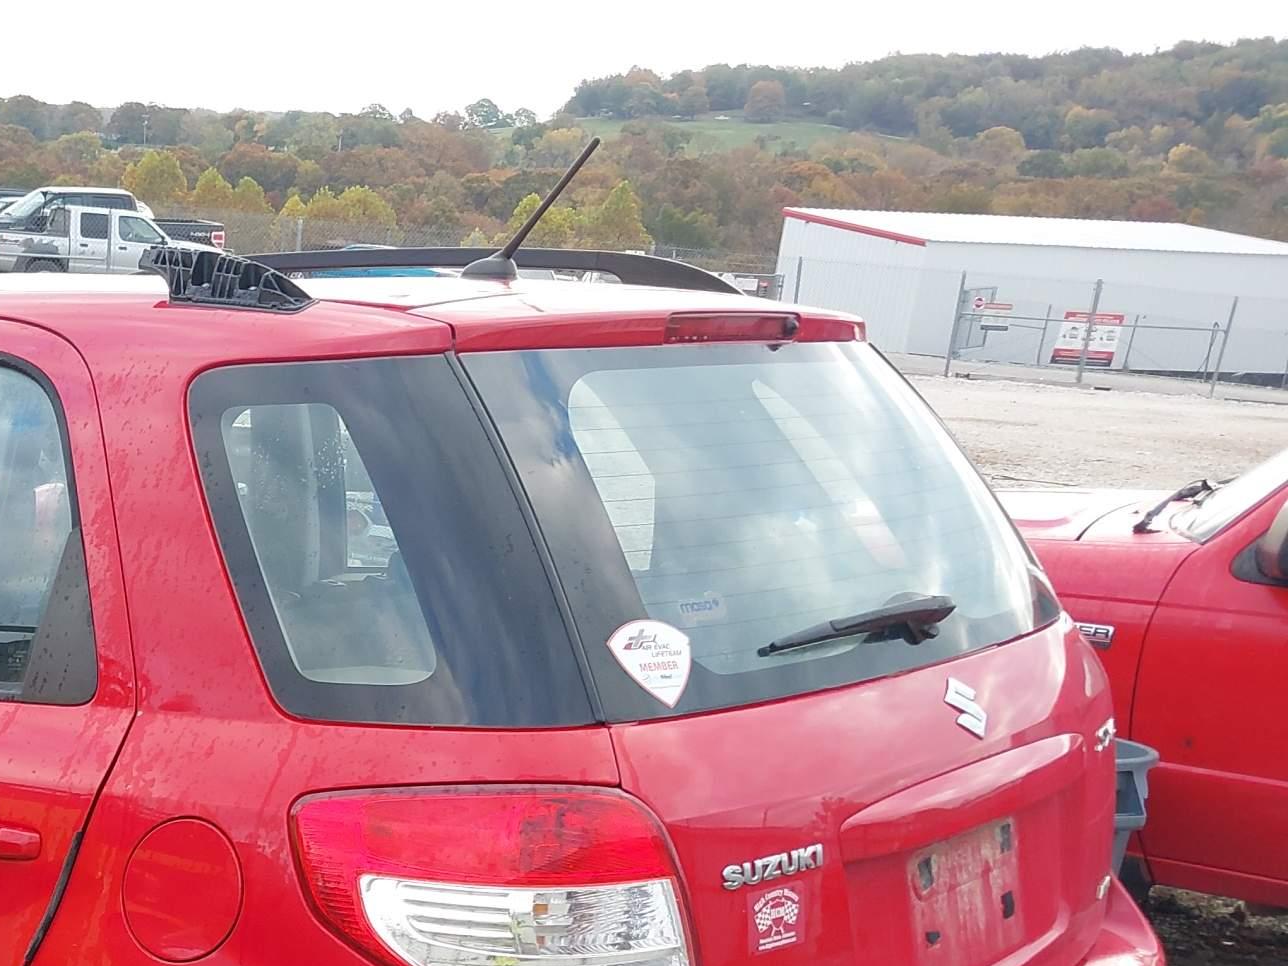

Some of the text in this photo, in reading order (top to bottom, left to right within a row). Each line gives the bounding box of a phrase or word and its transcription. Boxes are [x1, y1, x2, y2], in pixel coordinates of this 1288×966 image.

[654, 642, 671, 650] EVAC
[651, 648, 682, 658] LIFETEAM
[638, 660, 679, 673] MEMBER
[721, 843, 824, 891] SUZUKI
